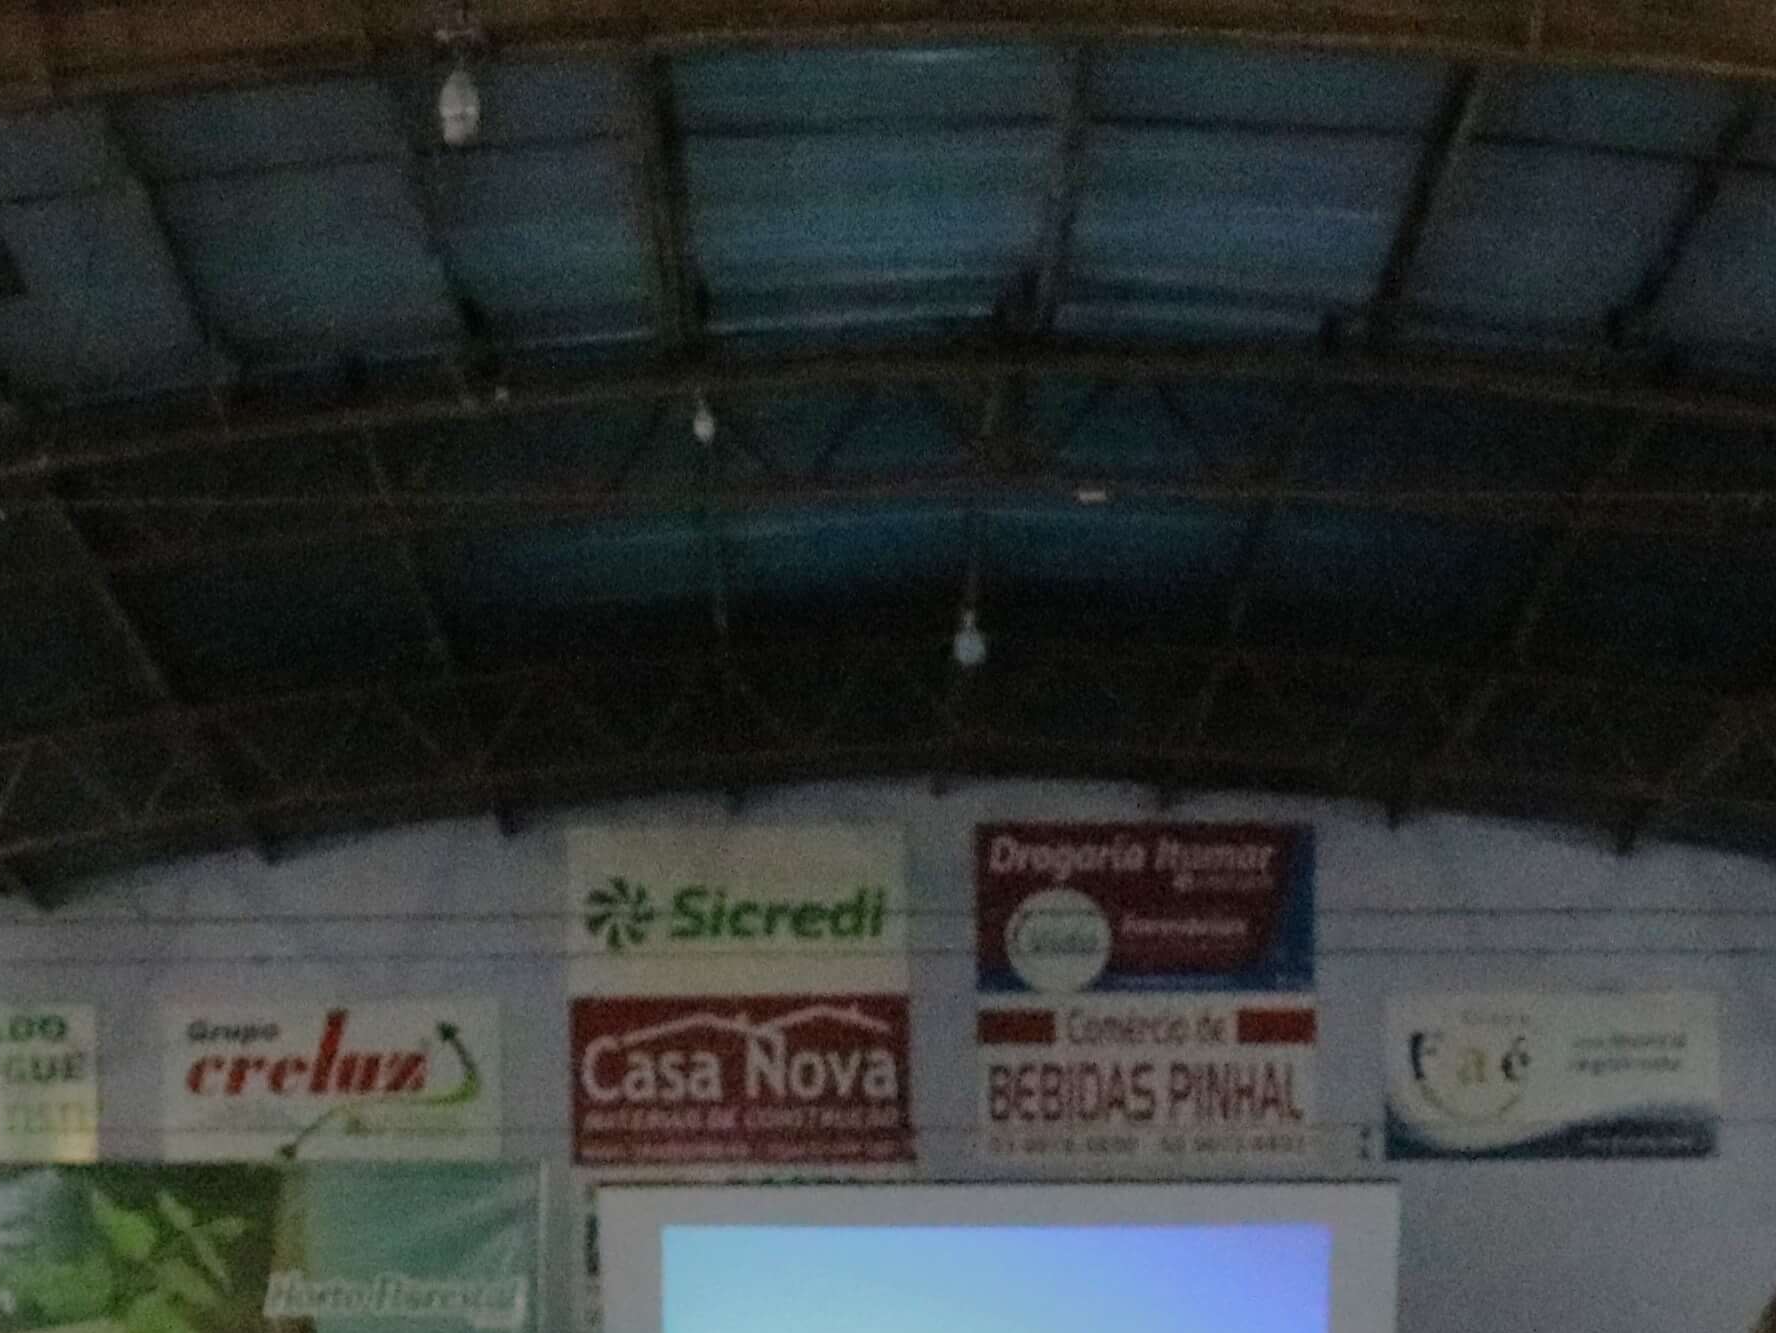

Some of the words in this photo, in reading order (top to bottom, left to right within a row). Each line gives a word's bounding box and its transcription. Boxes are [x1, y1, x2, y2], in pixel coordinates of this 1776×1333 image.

[669, 884, 885, 940] Sicredi
[185, 1007, 428, 1096] creluz
[583, 1036, 723, 1101] Casa
[744, 1024, 898, 1099] Nova
[988, 1061, 1158, 1123] BEBIDAS
[1167, 1061, 1306, 1123] PINHAL
